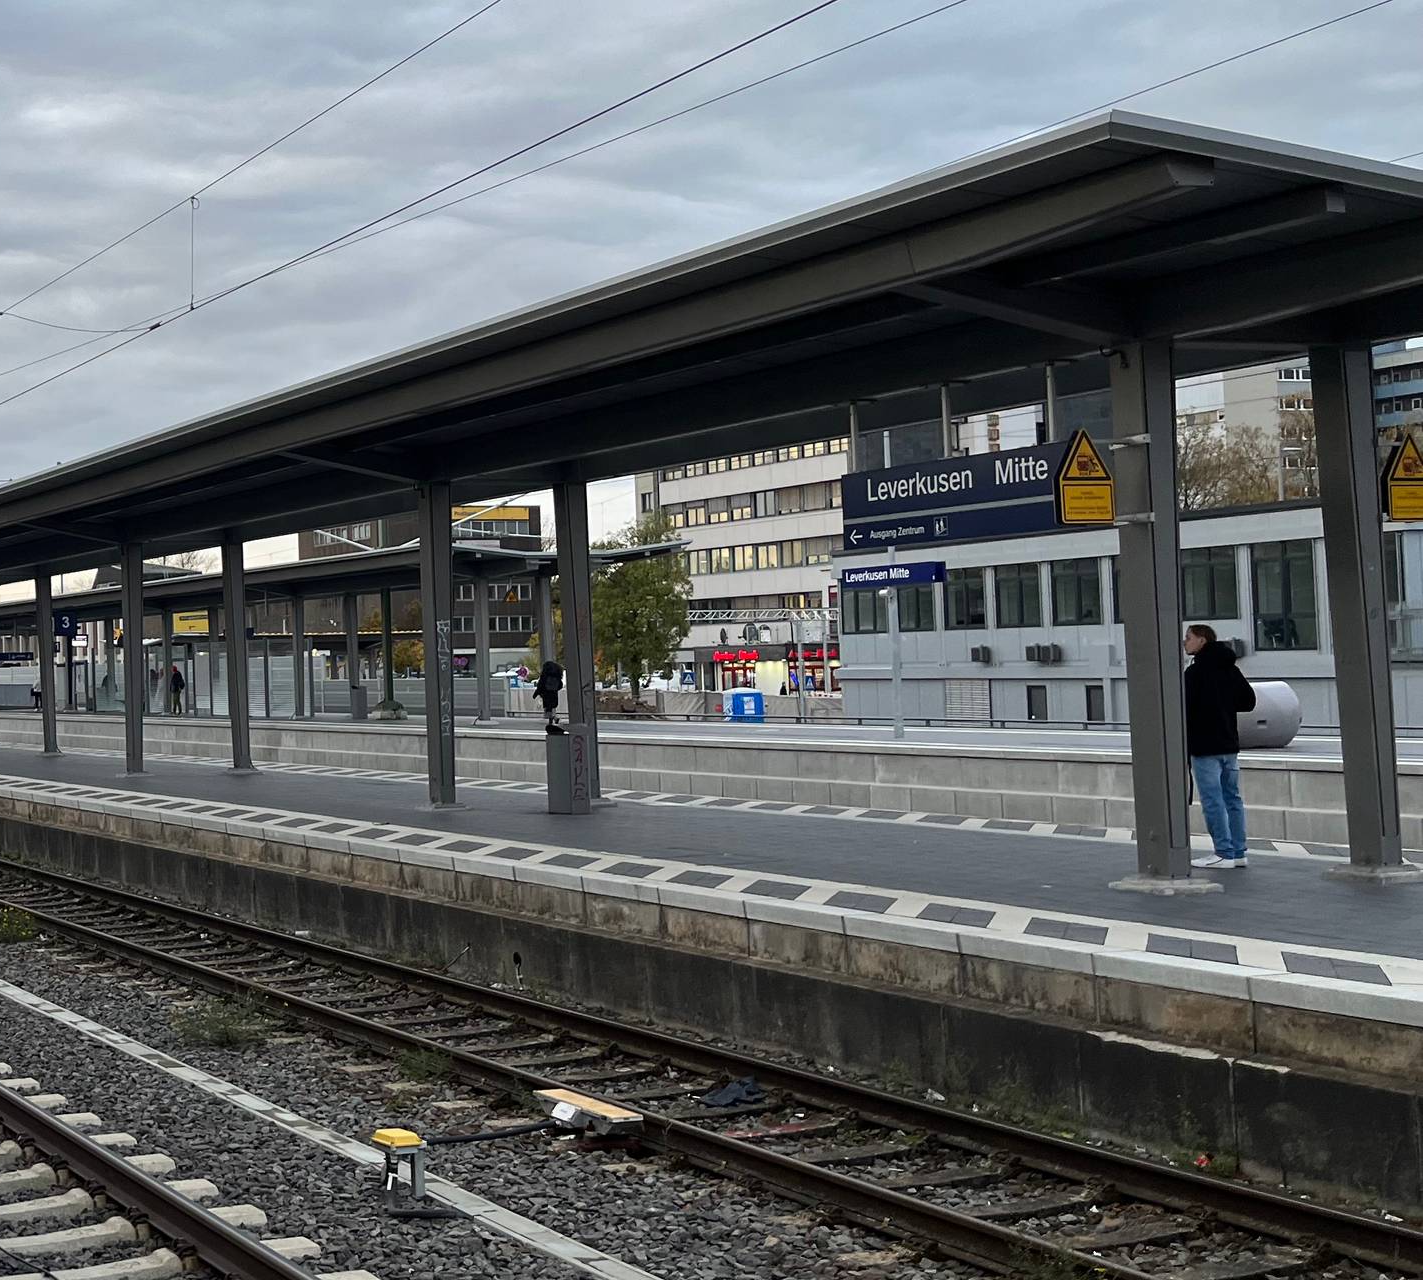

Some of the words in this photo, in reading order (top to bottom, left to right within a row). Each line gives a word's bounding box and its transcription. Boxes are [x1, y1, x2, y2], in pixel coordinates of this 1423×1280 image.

[866, 468, 973, 502] Leverkusen
[994, 455, 1048, 485] Mitte
[869, 525, 897, 541] Ausgang
[897, 524, 925, 537] Zentrum
[845, 569, 888, 583] Leverkusen
[889, 568, 910, 580] Mitte
[61, 616, 70, 629] 3
